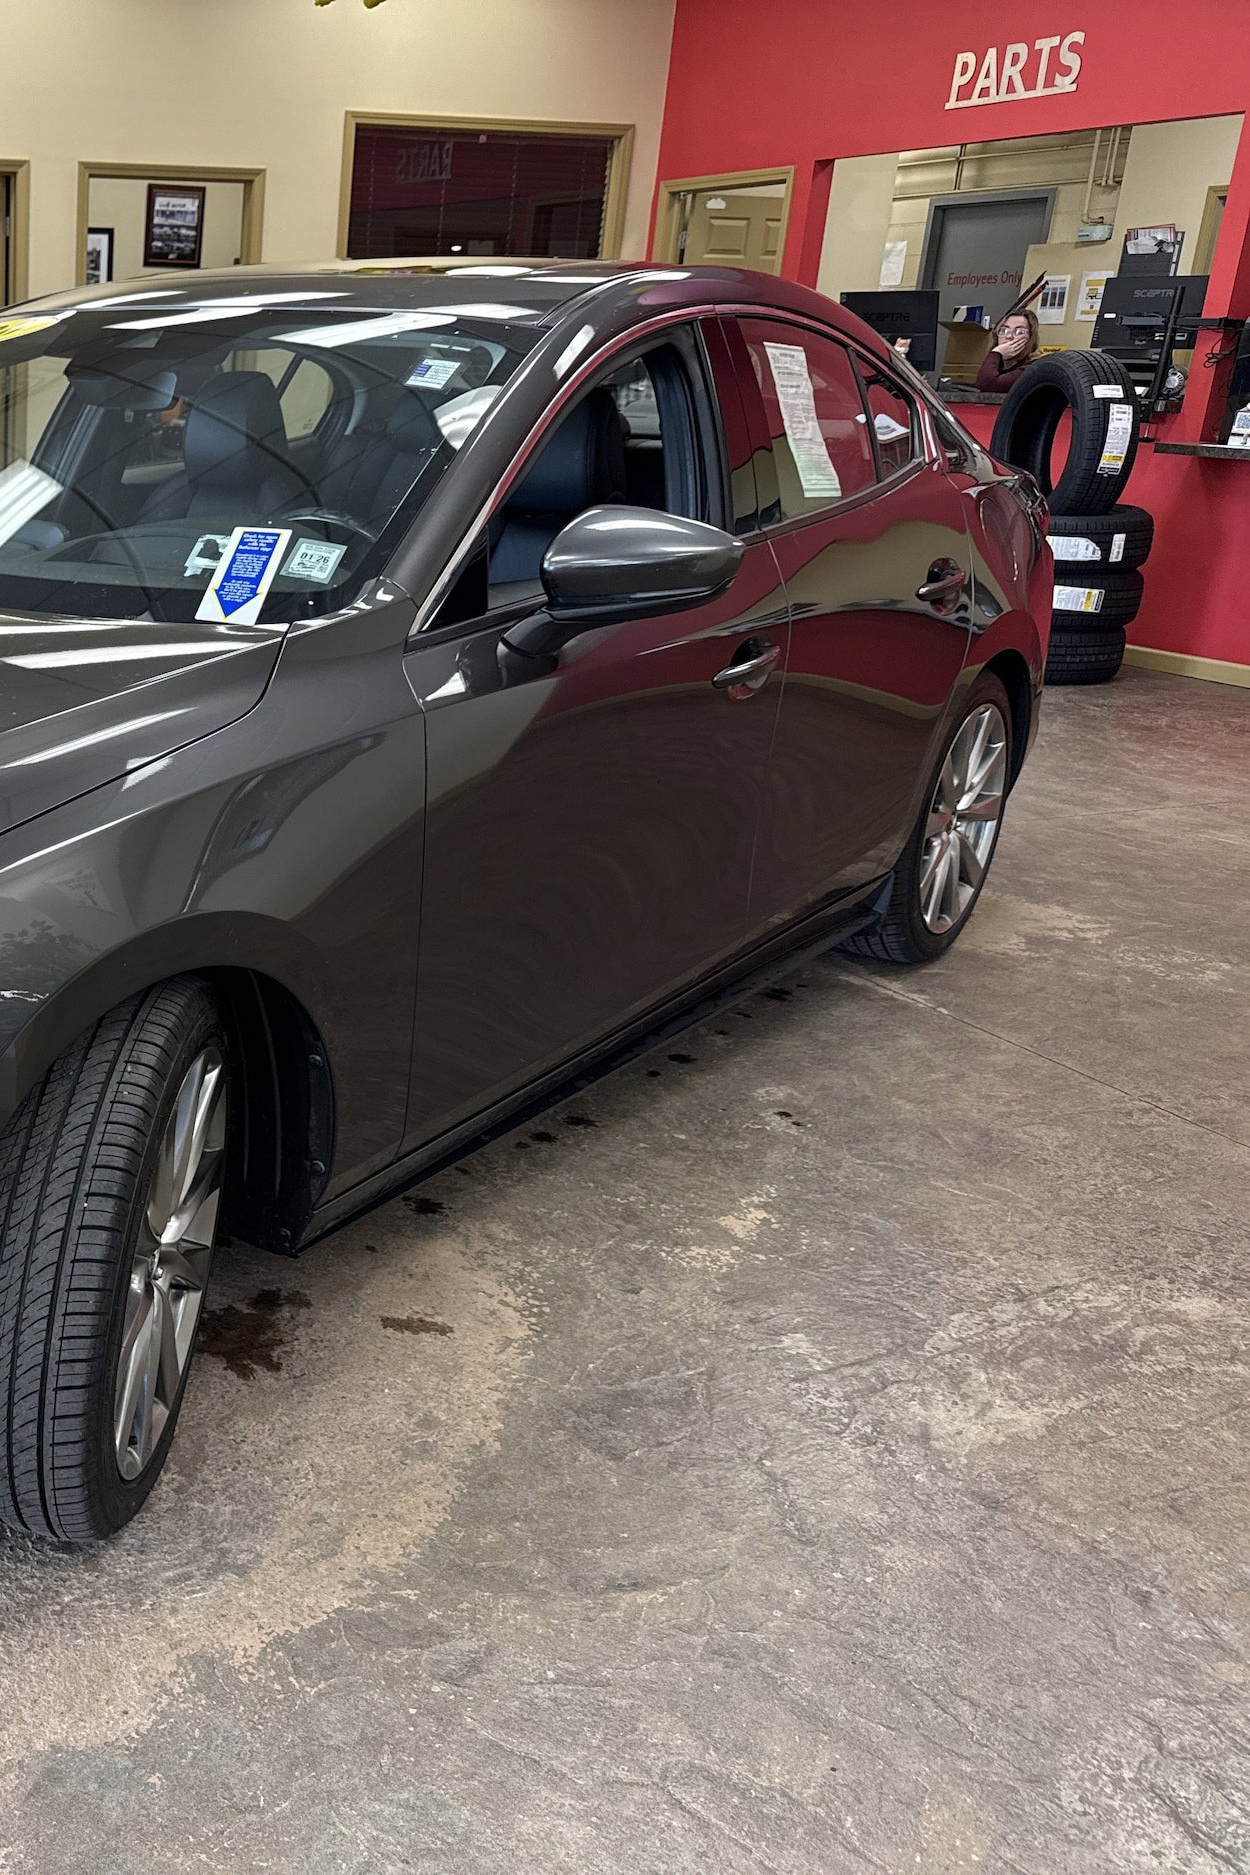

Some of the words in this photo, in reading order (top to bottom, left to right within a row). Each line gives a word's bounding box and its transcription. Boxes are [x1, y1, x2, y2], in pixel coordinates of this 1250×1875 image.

[946, 30, 1086, 107] PARTS
[947, 272, 998, 288] Employees
[1001, 270, 1023, 287] Only
[1133, 288, 1174, 298] SCEPTR
